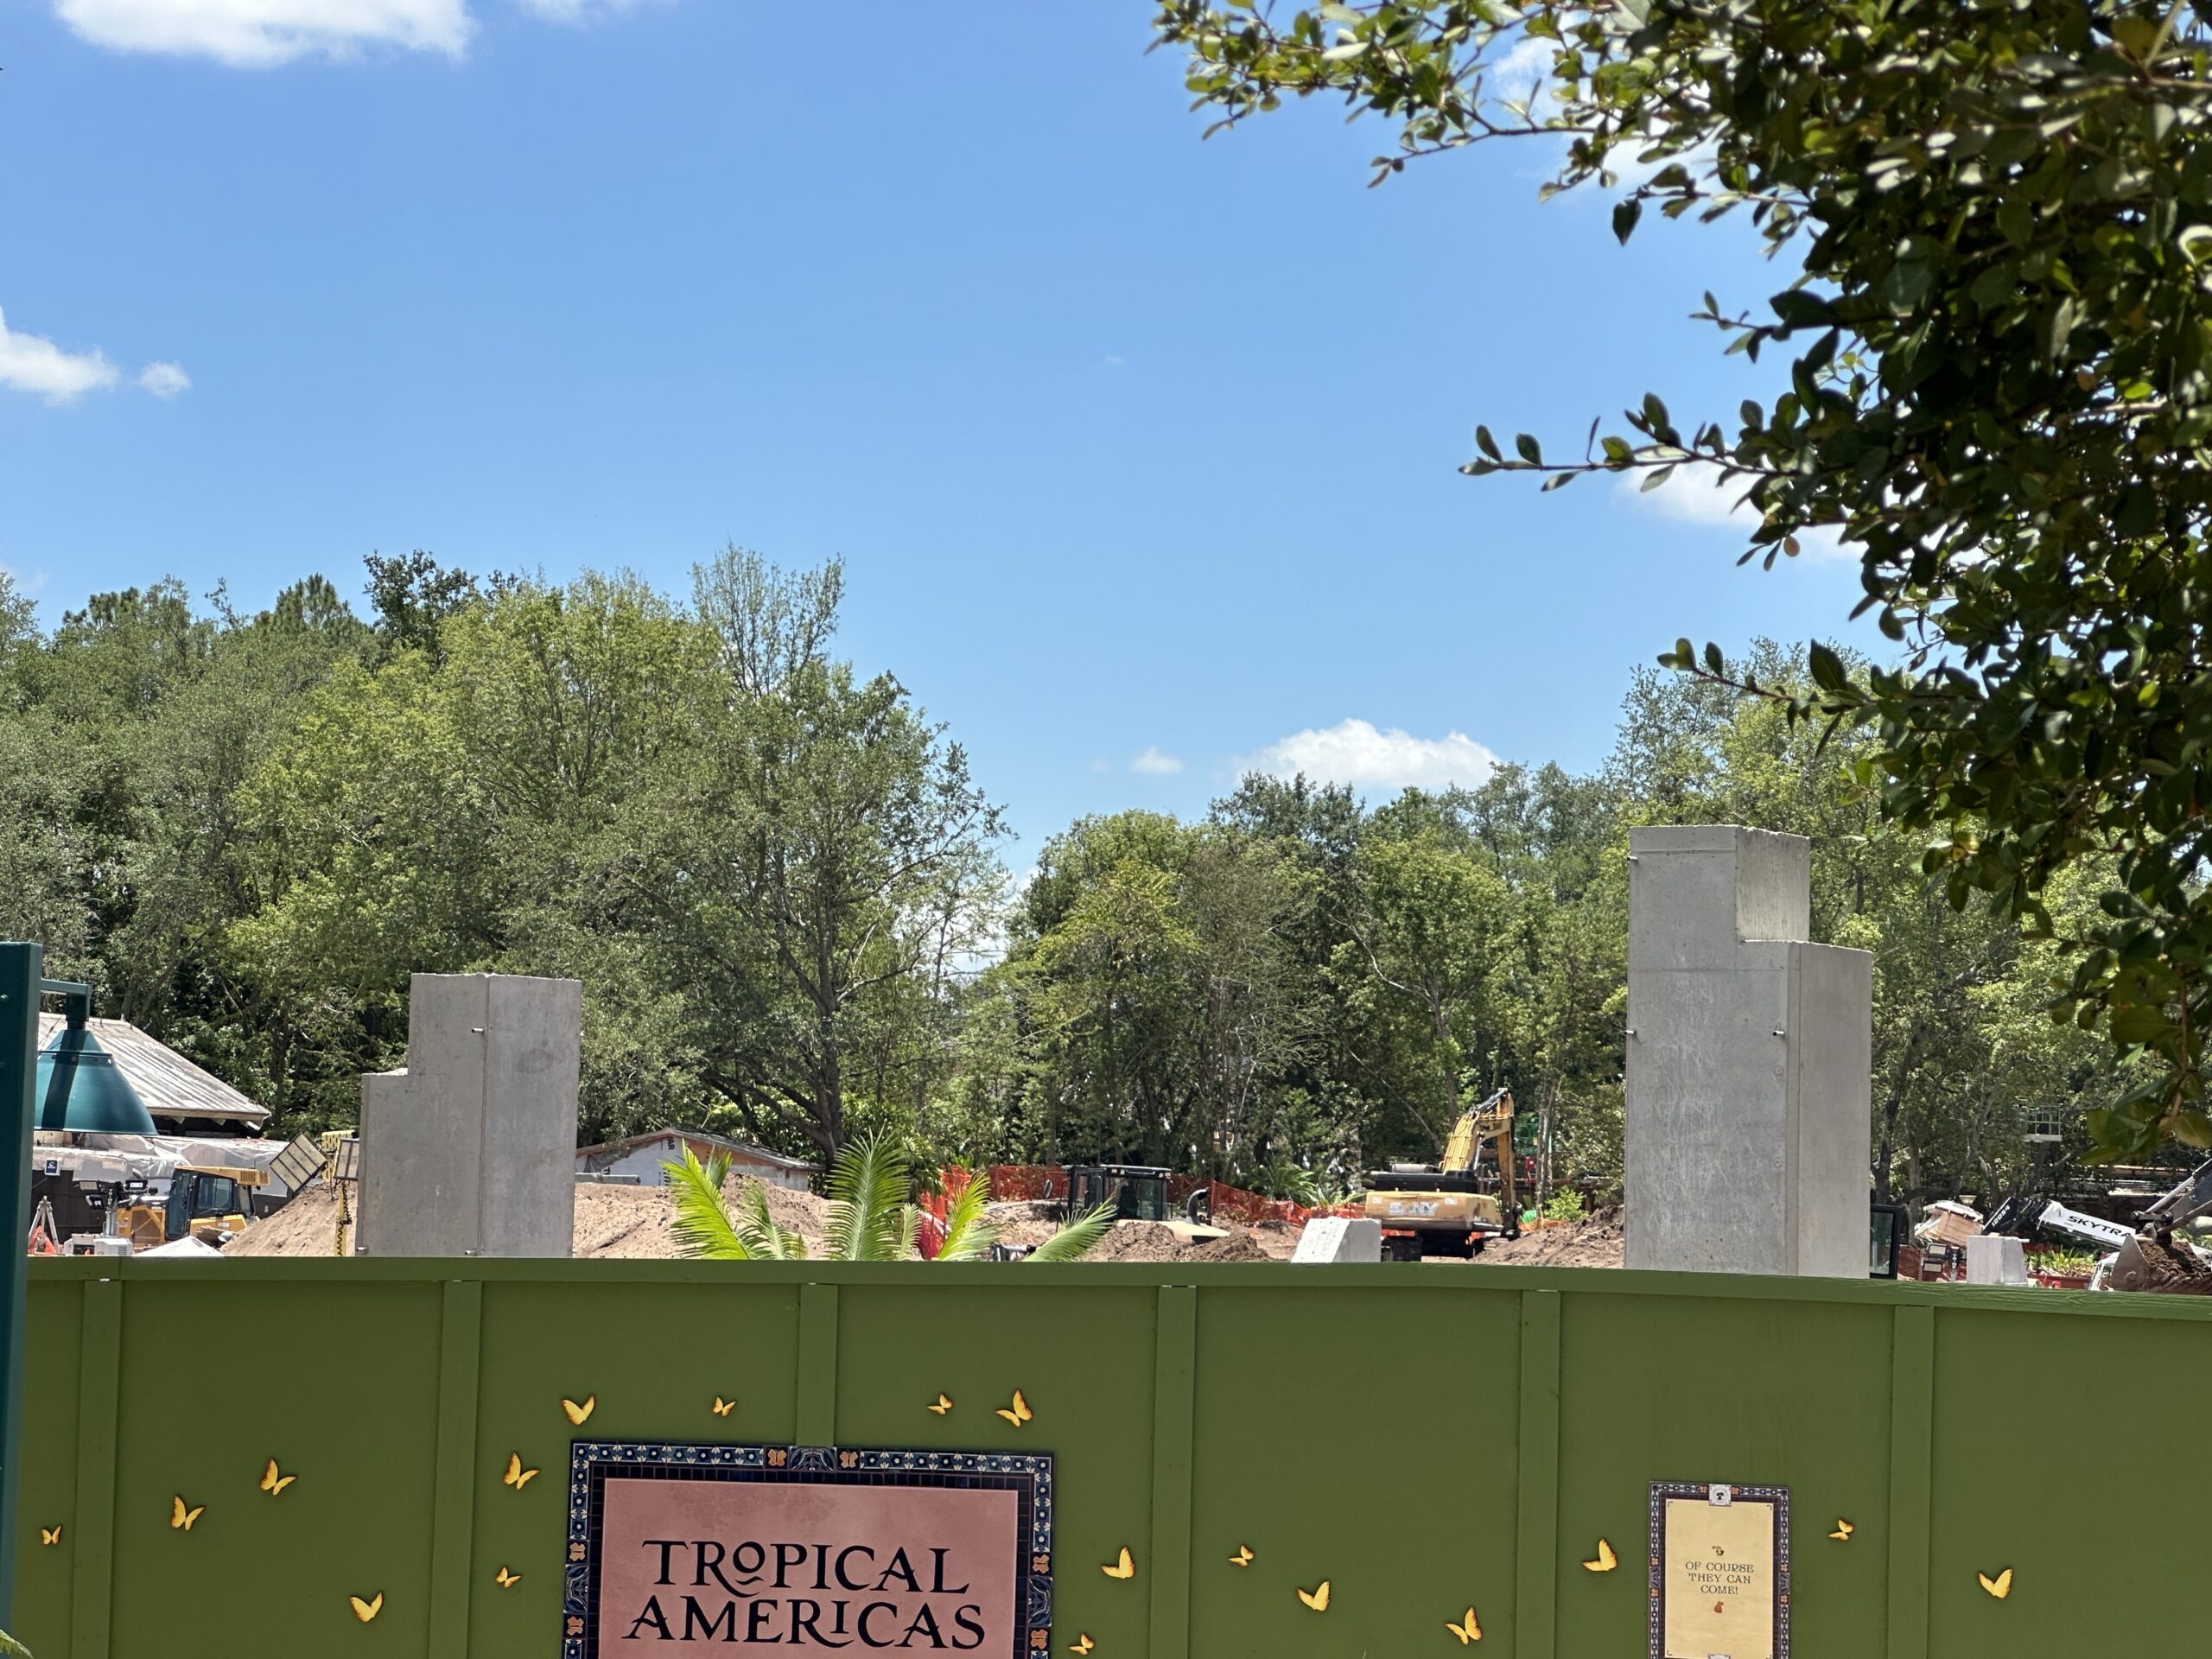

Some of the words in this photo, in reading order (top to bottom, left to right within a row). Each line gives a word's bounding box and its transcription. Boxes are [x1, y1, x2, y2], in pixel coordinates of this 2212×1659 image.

[641, 1540, 969, 1599] TROPICAL
[1685, 1560, 1701, 1570] OF
[1706, 1562, 1754, 1573] COURSE
[1688, 1573, 1721, 1583] THEY
[1726, 1574, 1751, 1584] CAN
[1700, 1585, 1738, 1595] COME!
[620, 1594, 985, 1650] AMERICAS
